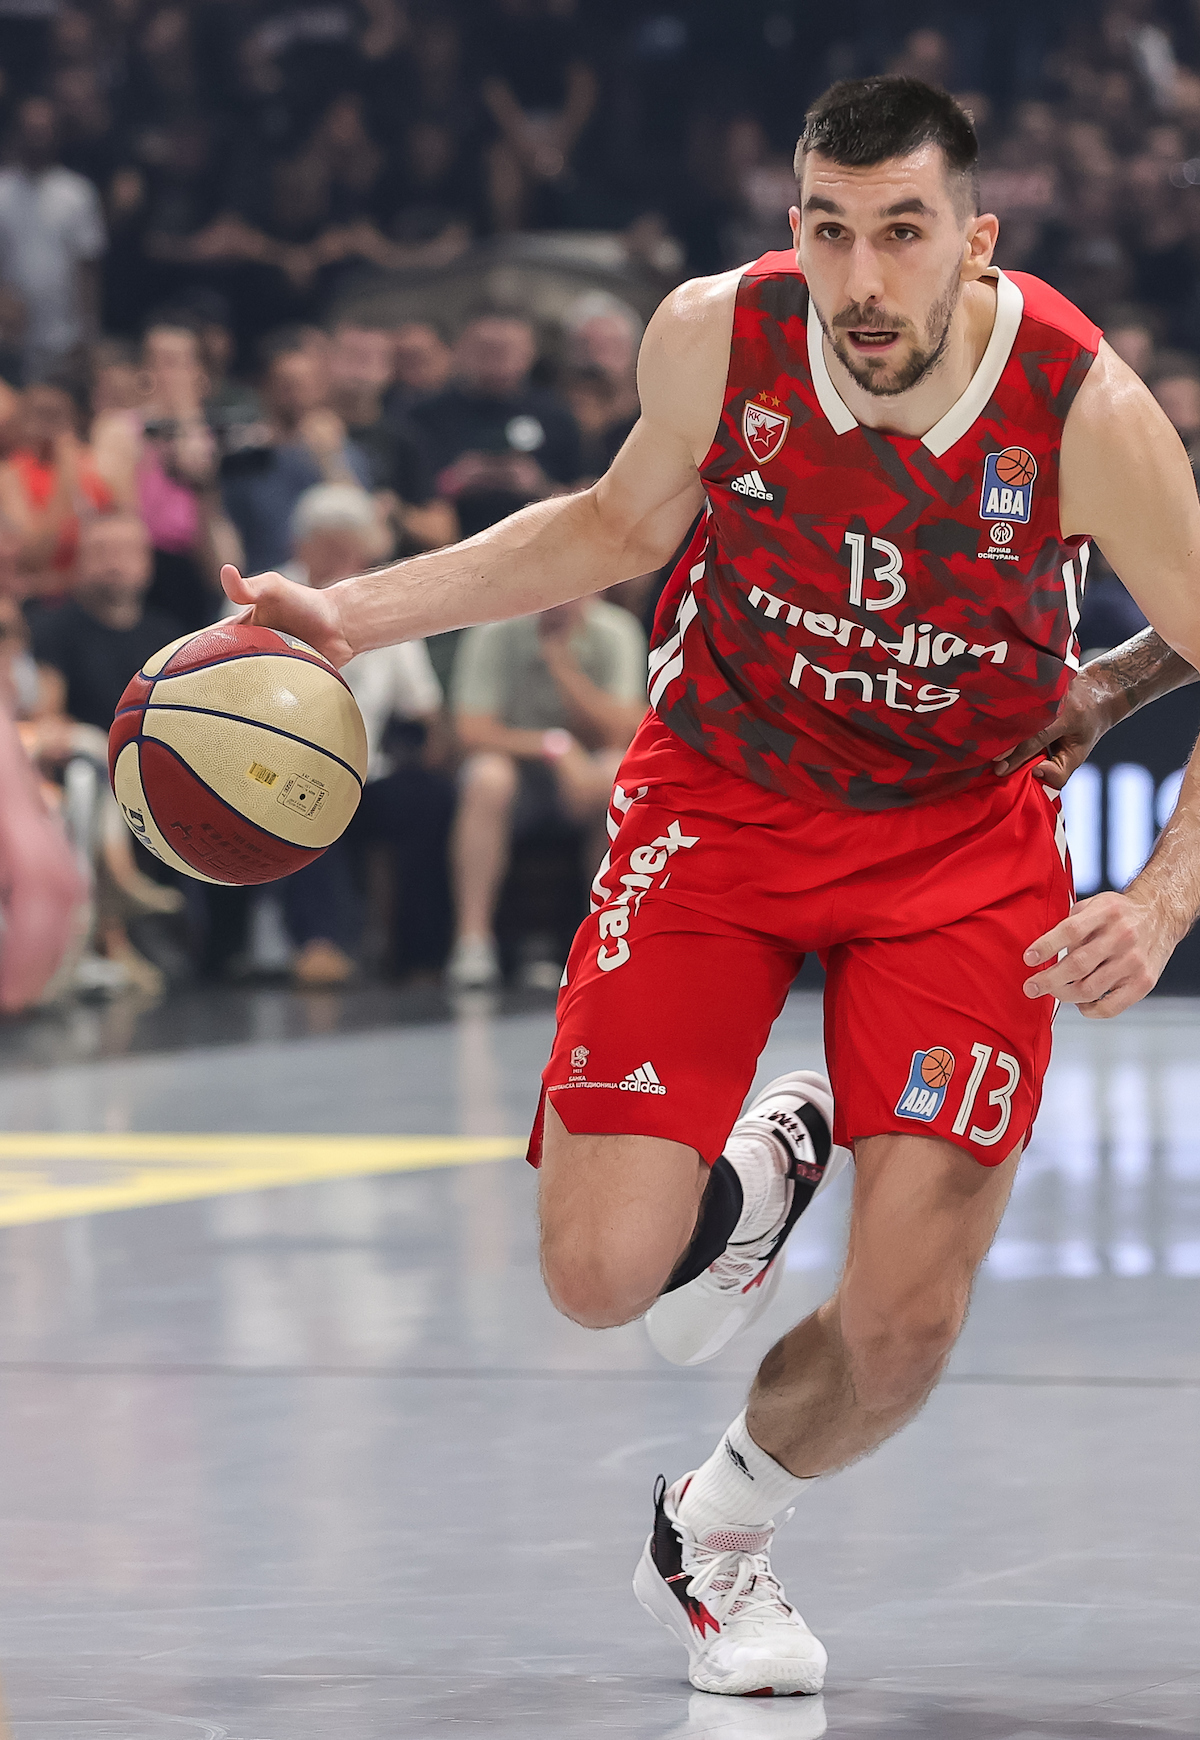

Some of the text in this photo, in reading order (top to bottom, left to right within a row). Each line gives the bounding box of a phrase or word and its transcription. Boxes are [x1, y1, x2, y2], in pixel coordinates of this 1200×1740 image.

[748, 410, 761, 421] KK
[730, 480, 774, 501] adidas
[985, 486, 1025, 517] ABA
[844, 530, 907, 612] 13
[788, 651, 961, 714] mts
[619, 1080, 667, 1096] adidas
[900, 1086, 939, 1117] ABA
[951, 1041, 1021, 1147] 13
